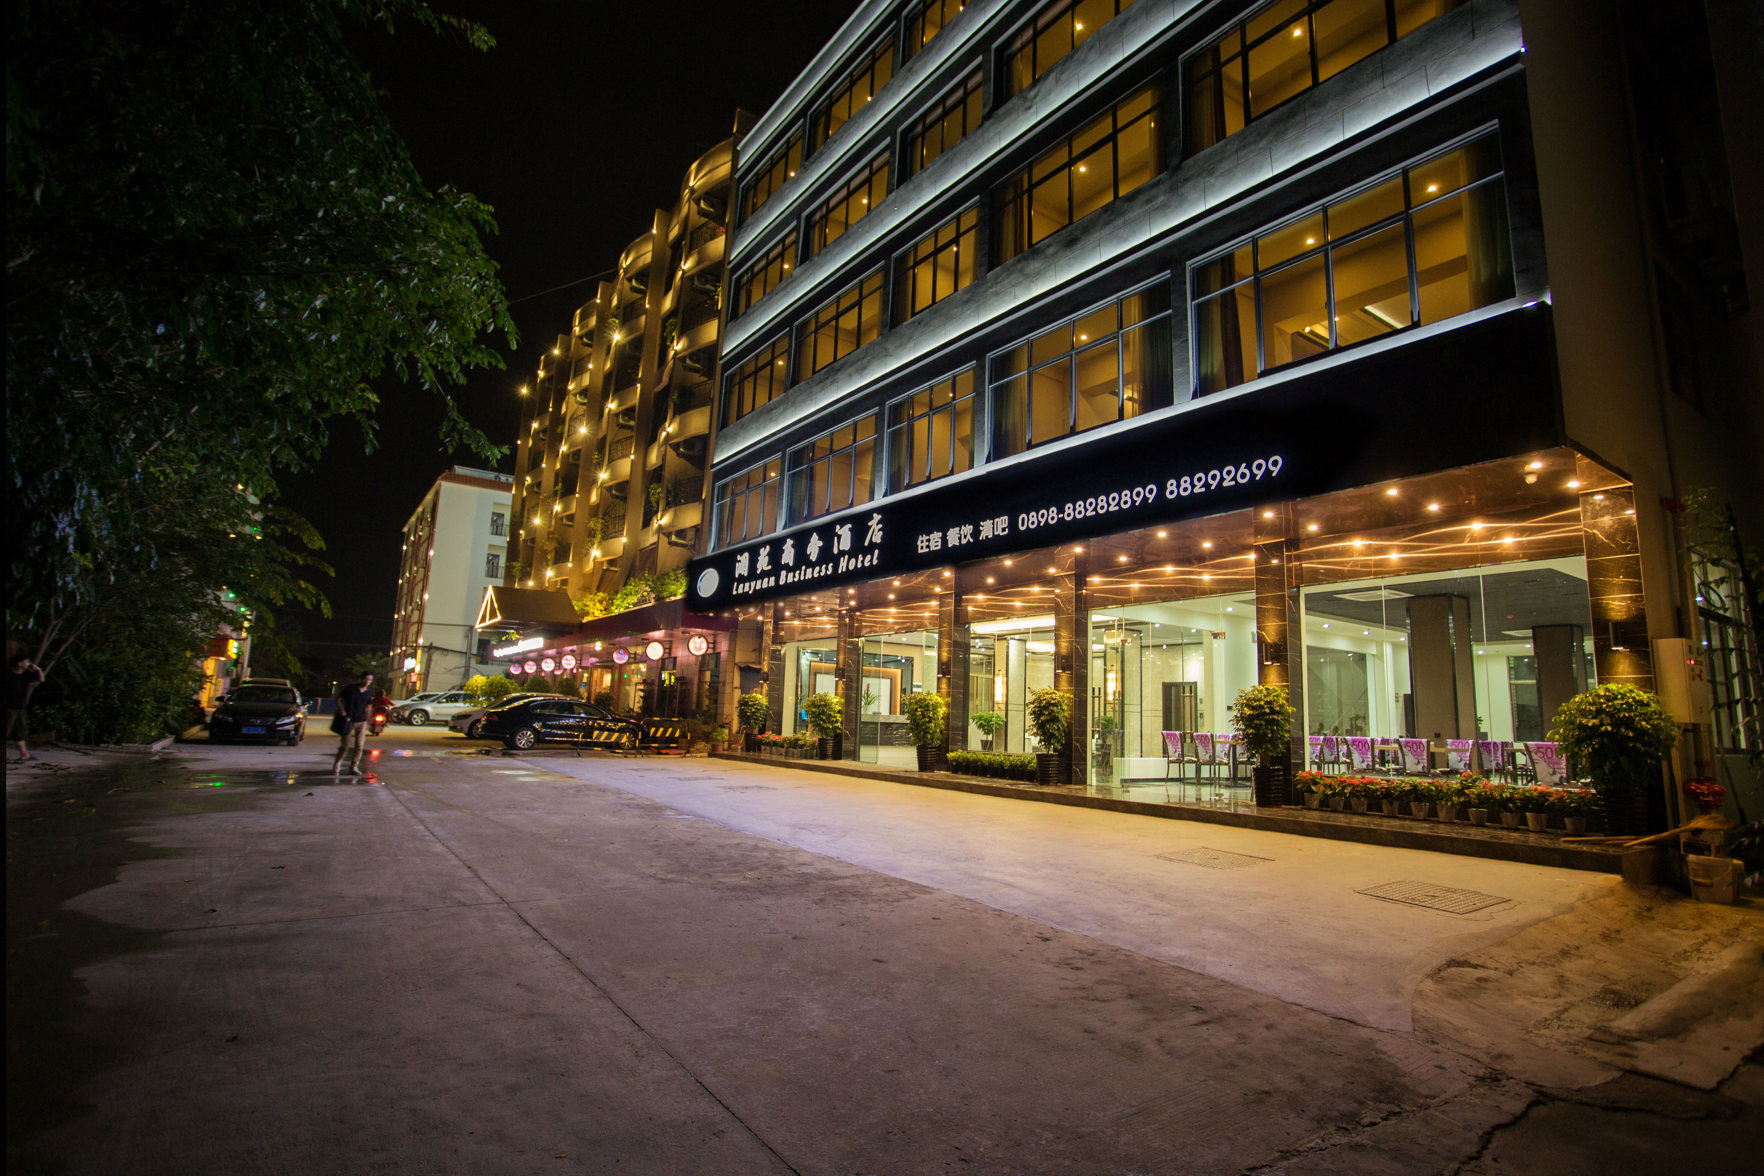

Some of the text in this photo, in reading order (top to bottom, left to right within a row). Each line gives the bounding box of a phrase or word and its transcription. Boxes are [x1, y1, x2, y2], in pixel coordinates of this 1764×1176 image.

[916, 455, 1283, 554] 住宿 餐饮 清吧 0898-88282899 88292699
[732, 549, 879, 595] Lanyuan Business Hotel
[1352, 740, 1370, 751] 500
[1405, 741, 1425, 752] 500
